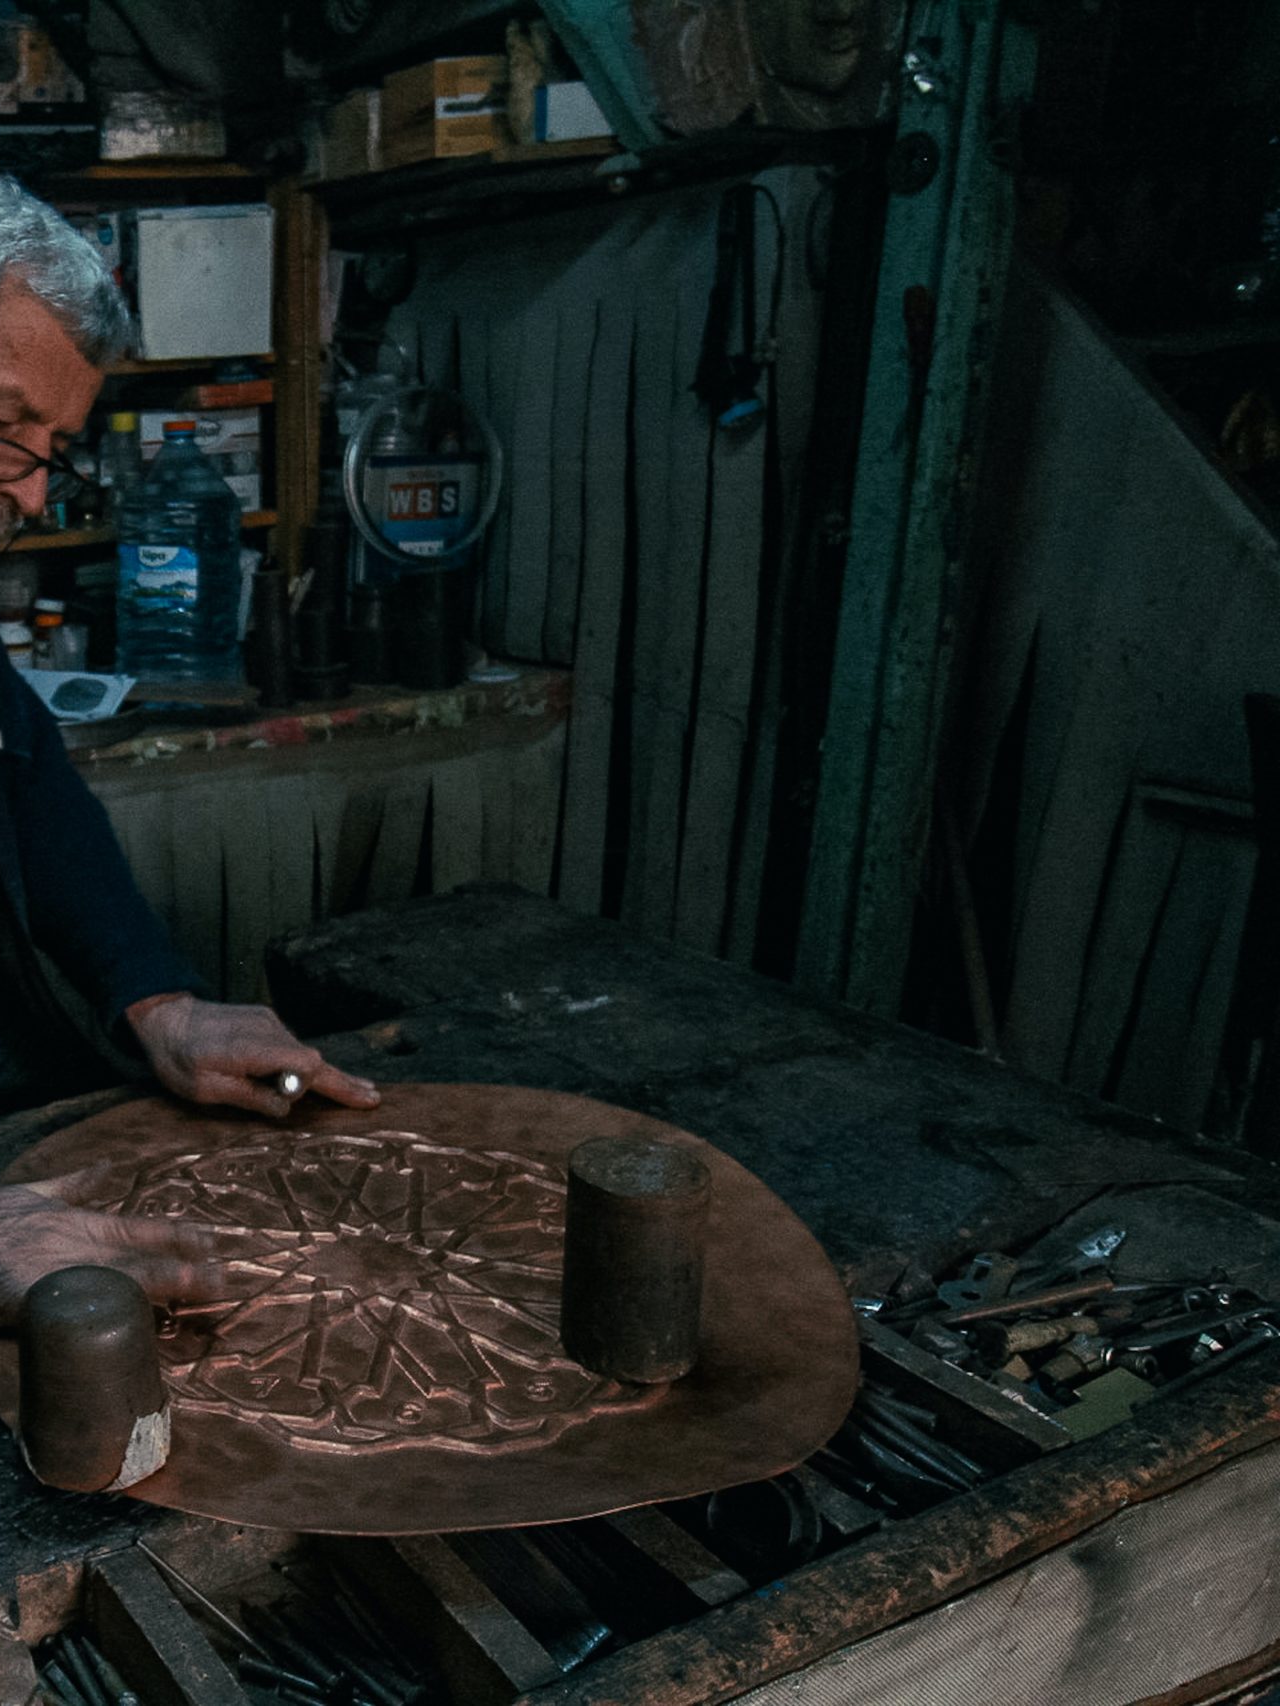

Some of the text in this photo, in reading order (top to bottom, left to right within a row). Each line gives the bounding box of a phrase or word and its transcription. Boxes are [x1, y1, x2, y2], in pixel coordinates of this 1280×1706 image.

[390, 486, 457, 513] WBS
[250, 1373, 281, 1398] 7
[524, 1376, 556, 1402] 5
[393, 1401, 424, 1425] 6
